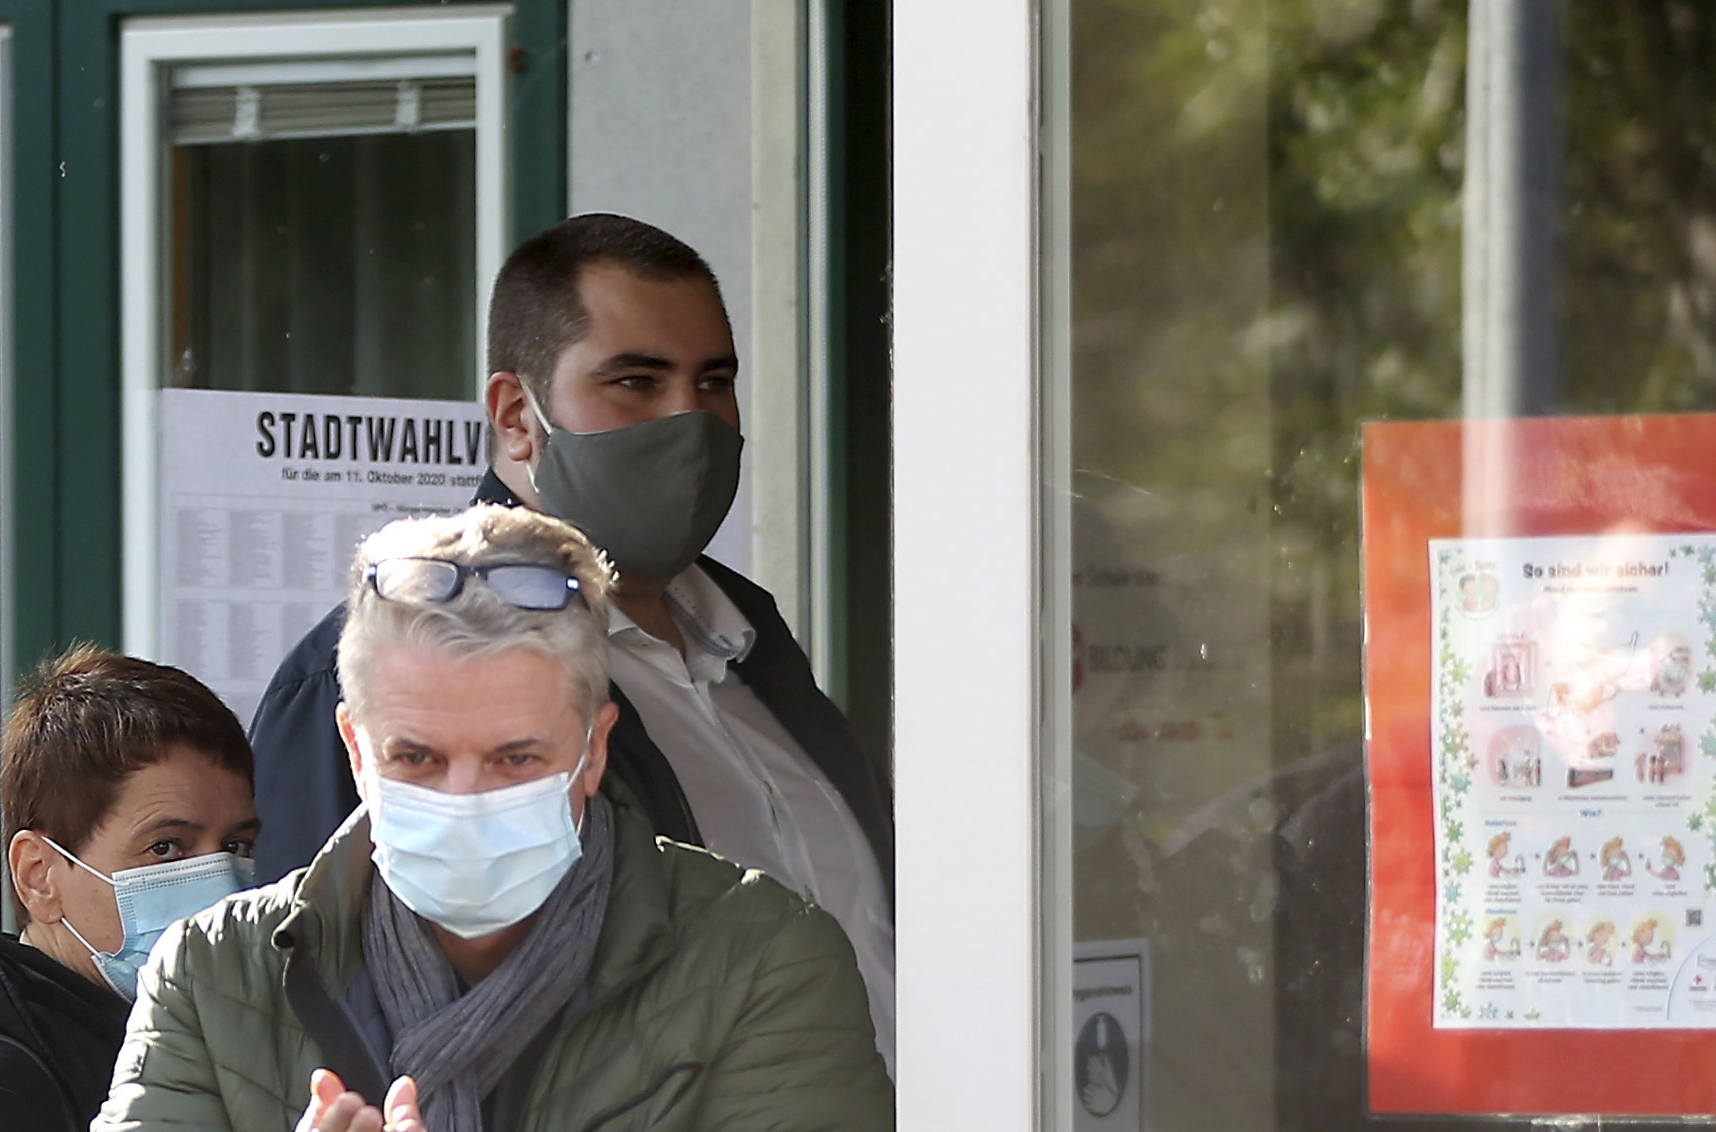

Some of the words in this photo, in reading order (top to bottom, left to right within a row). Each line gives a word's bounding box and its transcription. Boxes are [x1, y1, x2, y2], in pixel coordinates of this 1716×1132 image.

[256, 411, 490, 465] STADTWAHLV
[281, 467, 299, 480] für
[302, 468, 320, 480] die
[324, 471, 341, 481] am
[345, 469, 363, 482] 11.
[367, 470, 413, 485] Oktober
[417, 473, 446, 486] 2020
